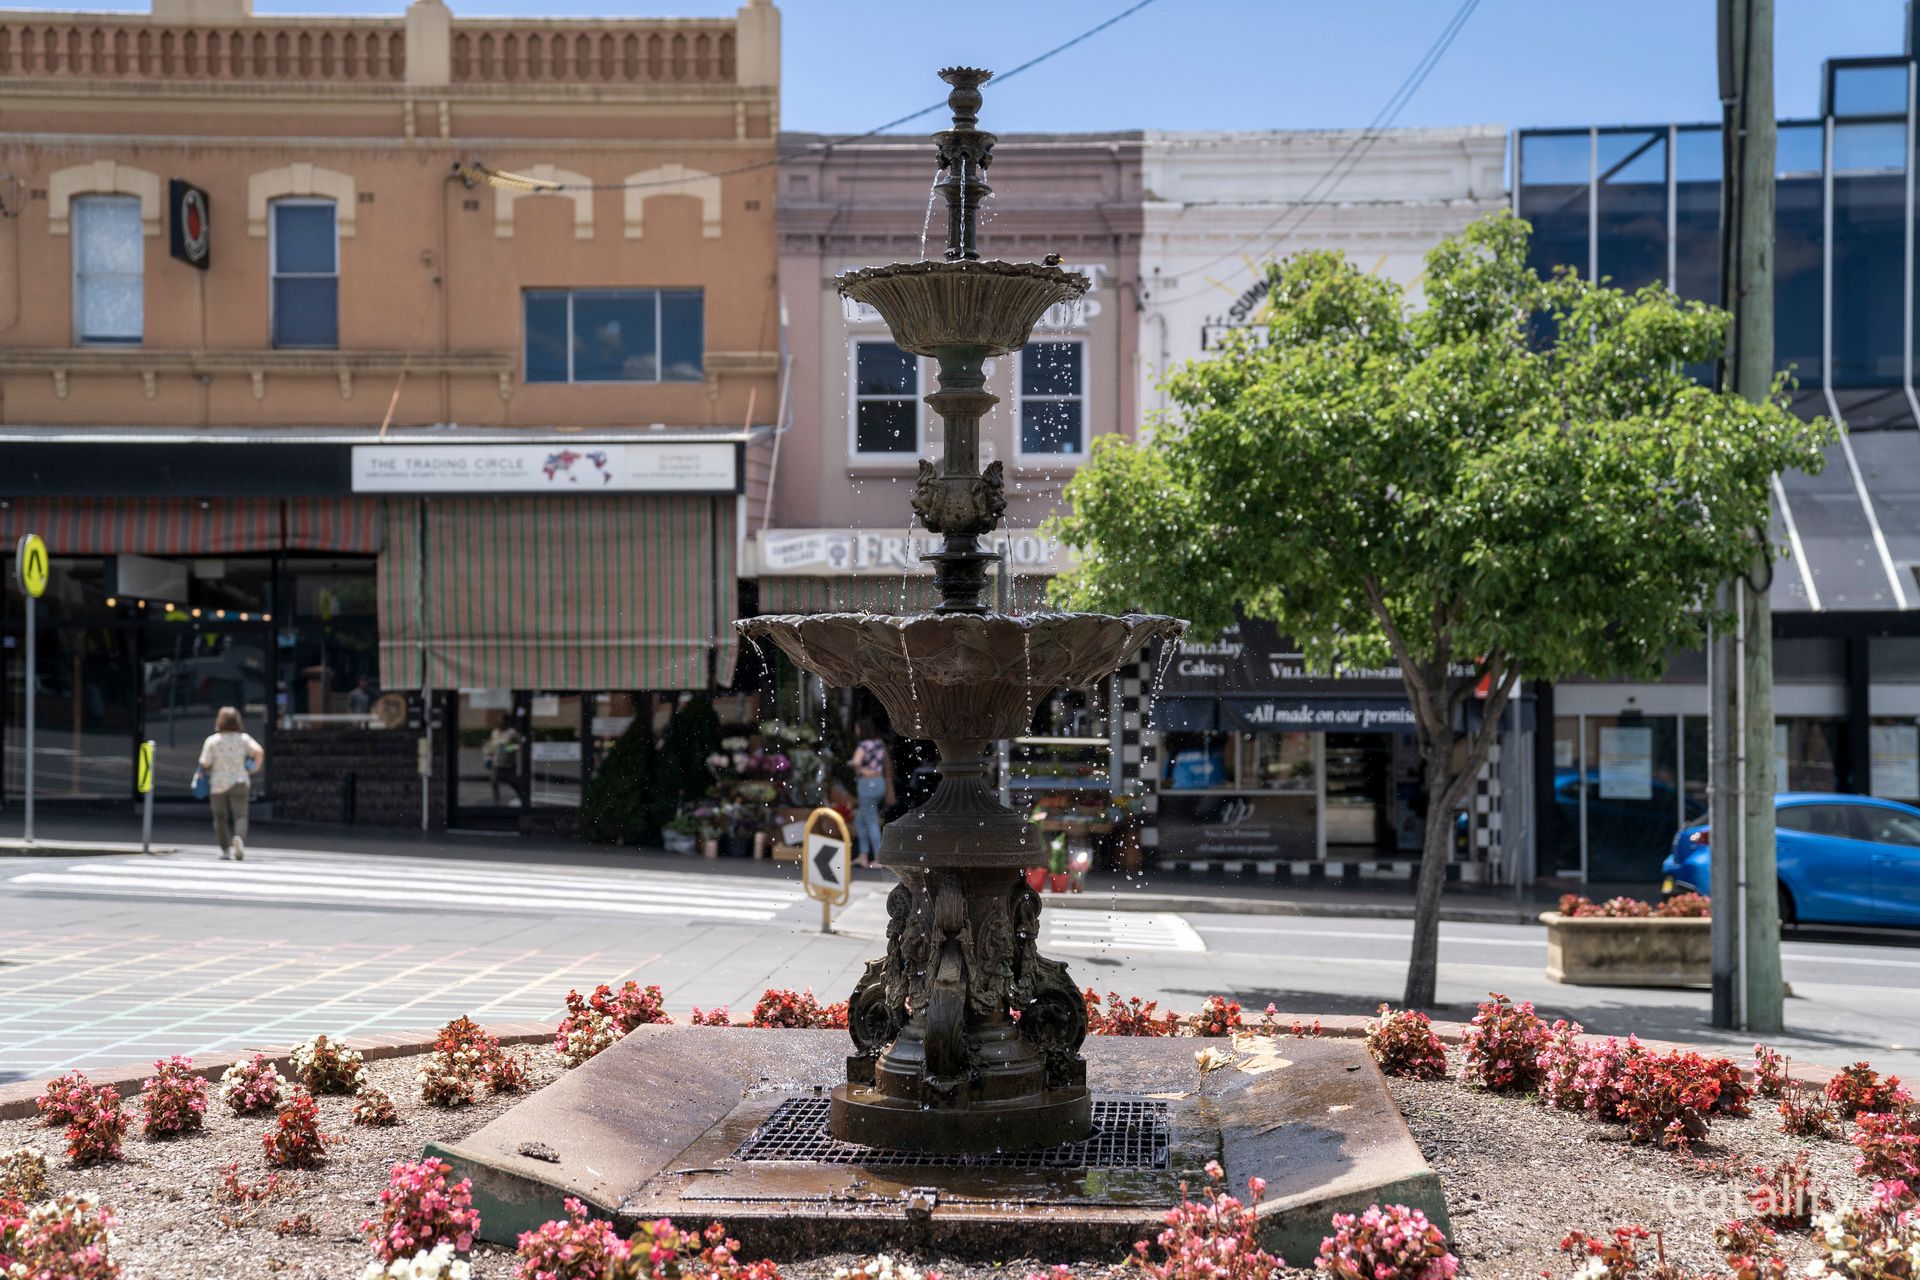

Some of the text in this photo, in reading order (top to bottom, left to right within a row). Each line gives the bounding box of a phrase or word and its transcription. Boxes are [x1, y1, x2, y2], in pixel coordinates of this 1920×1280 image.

[370, 457, 525, 470] THE TRADING CIRCLE
[1178, 659, 1226, 676] Cakes
[1275, 704, 1315, 723] made
[1315, 709, 1335, 723] on
[1335, 709, 1363, 723] our
